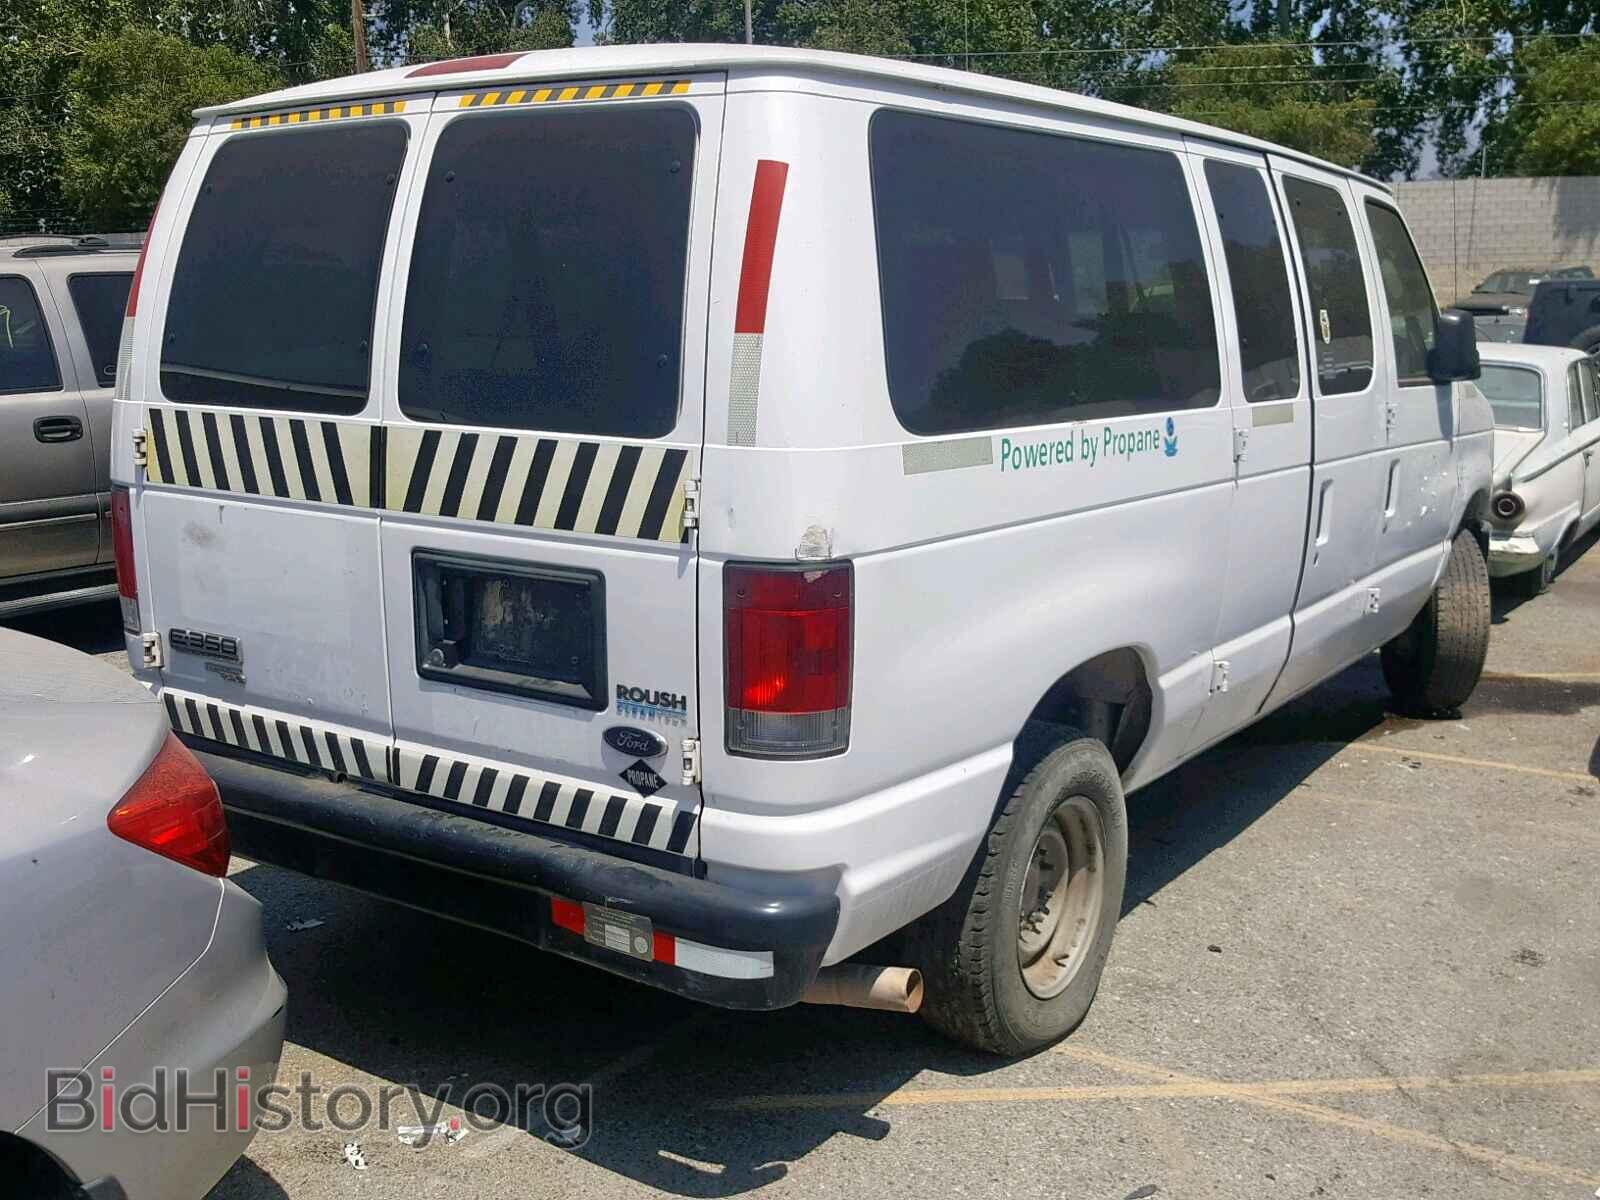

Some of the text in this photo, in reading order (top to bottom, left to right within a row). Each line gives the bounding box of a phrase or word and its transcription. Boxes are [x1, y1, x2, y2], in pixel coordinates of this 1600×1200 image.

[1001, 426, 1160, 472] Powered by Propane
[616, 684, 687, 711] ROUSH
[616, 730, 650, 752] Ford
[626, 769, 659, 789] PROPANE
